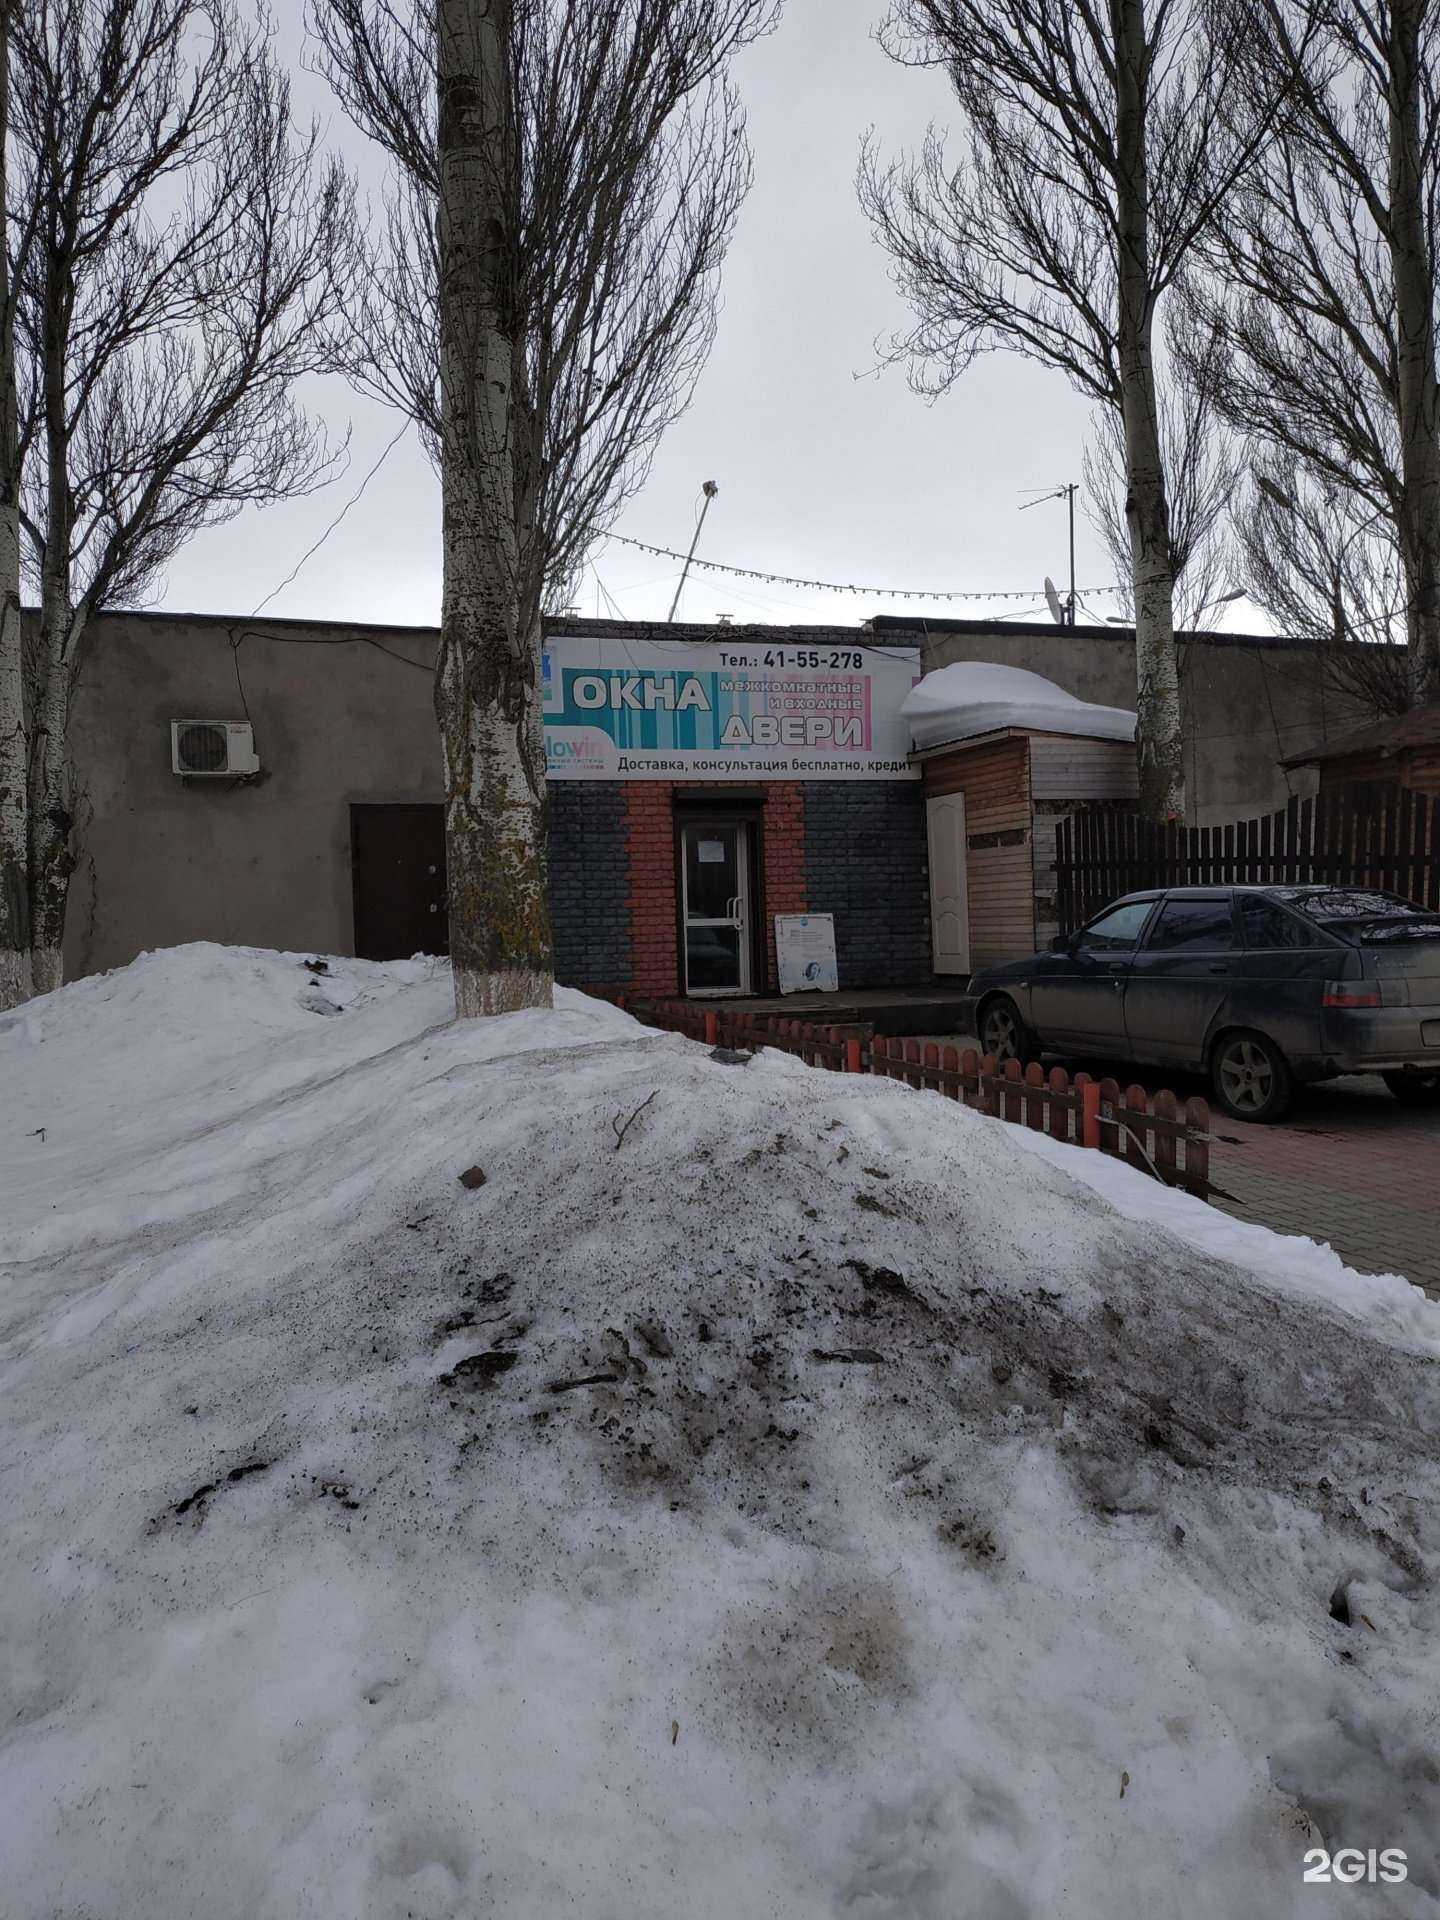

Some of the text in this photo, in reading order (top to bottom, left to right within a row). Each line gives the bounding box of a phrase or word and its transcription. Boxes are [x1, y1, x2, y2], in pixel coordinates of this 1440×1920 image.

[719, 651, 863, 669] Тел.: 41-55-278
[572, 676, 712, 712] ОКНА
[720, 680, 862, 694] межкомнатные
[784, 698, 863, 710] входные
[720, 715, 863, 746] ДВЕРИ
[618, 757, 688, 773] Доставка,
[693, 759, 787, 773] консультация
[792, 757, 864, 773] бесплатно,
[868, 760, 913, 774] кредит
